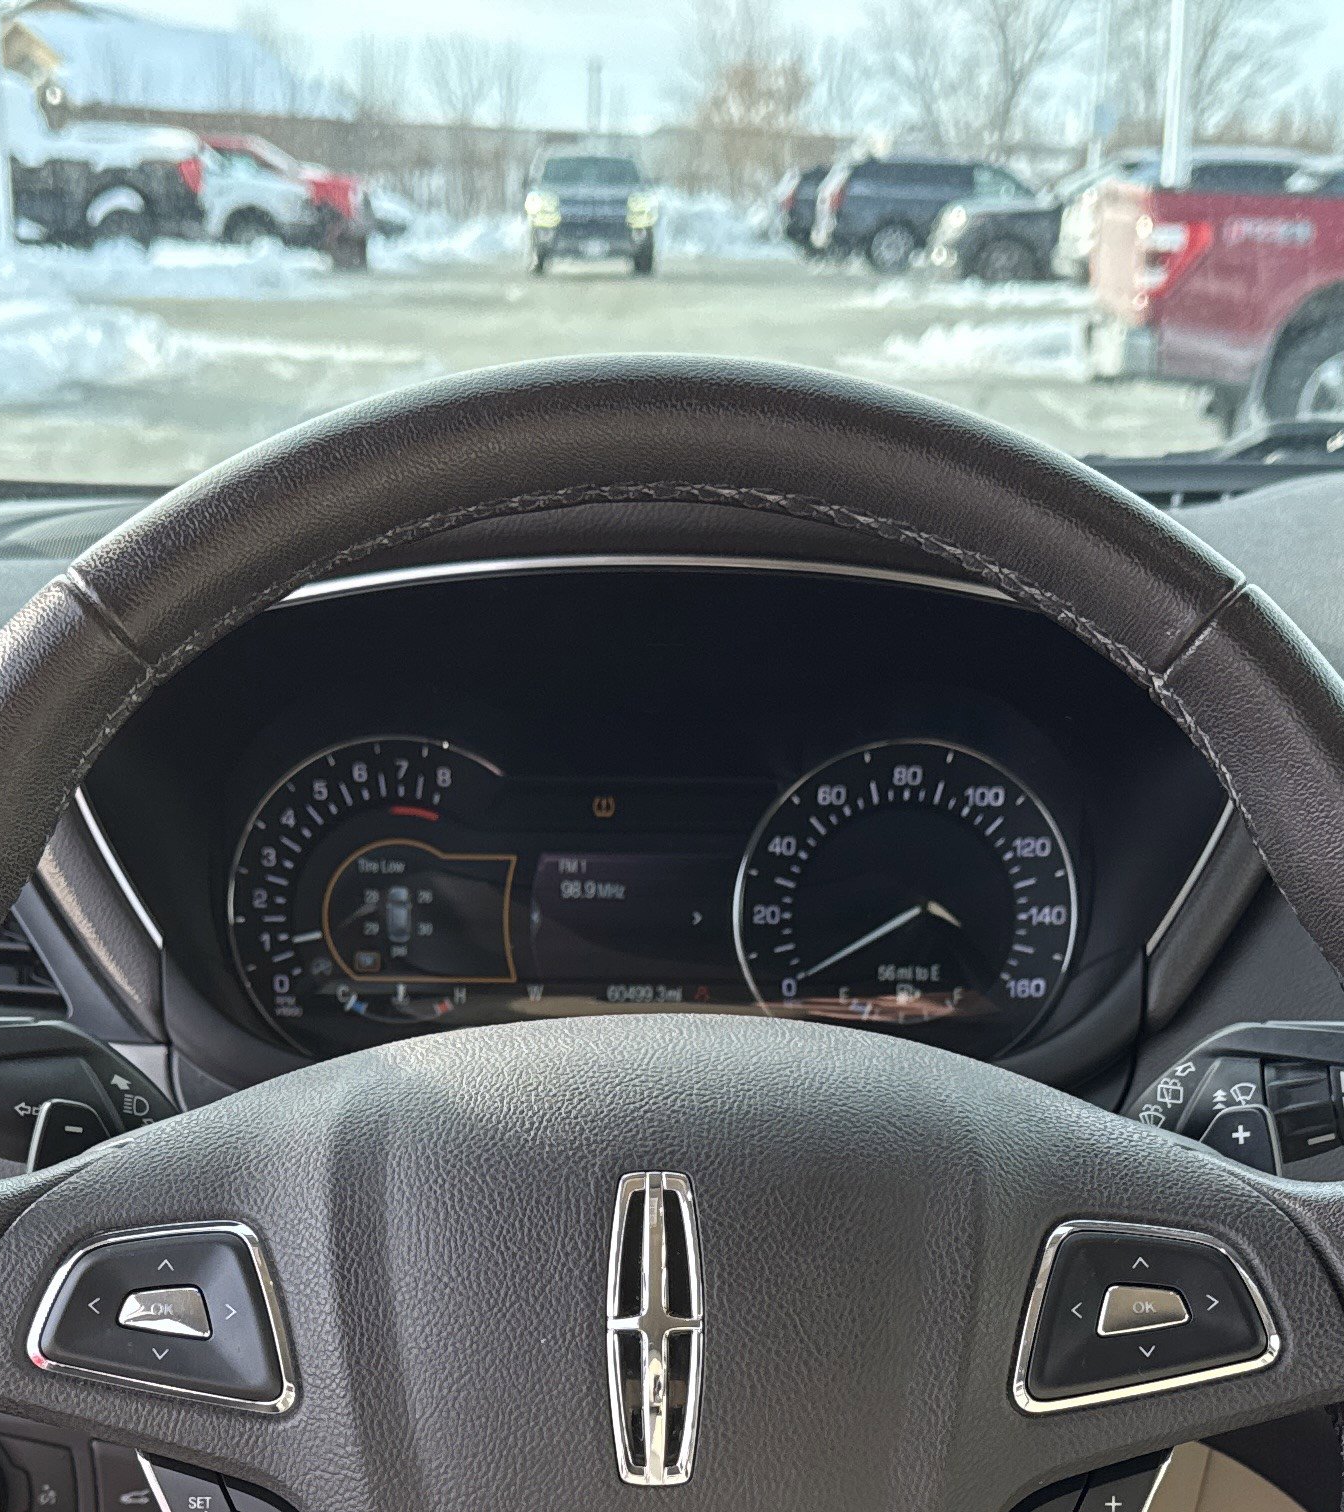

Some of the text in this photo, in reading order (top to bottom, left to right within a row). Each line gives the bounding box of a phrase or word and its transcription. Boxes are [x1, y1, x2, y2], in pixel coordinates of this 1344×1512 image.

[352, 761, 368, 783] 6
[395, 758, 409, 780] 7
[436, 766, 452, 788] 8
[892, 765, 923, 786] 80
[313, 779, 328, 801] 5
[816, 785, 847, 806] 60
[964, 786, 1005, 807] 100
[280, 806, 296, 828] 4
[261, 846, 276, 867] 3
[767, 836, 796, 856] 40
[1011, 836, 1052, 858] 120
[558, 859, 578, 874] FM
[252, 888, 268, 909] 2
[753, 904, 781, 925] 20
[1027, 904, 1067, 926] 140
[260, 932, 271, 952] 1
[273, 974, 289, 993] 0
[930, 964, 941, 982] E
[454, 985, 467, 1004] H
[781, 978, 797, 998] 0
[1007, 978, 1047, 998] 160
[151, 1303, 174, 1316] OK
[1132, 1301, 1156, 1314] OK
[188, 1497, 212, 1509] SET
